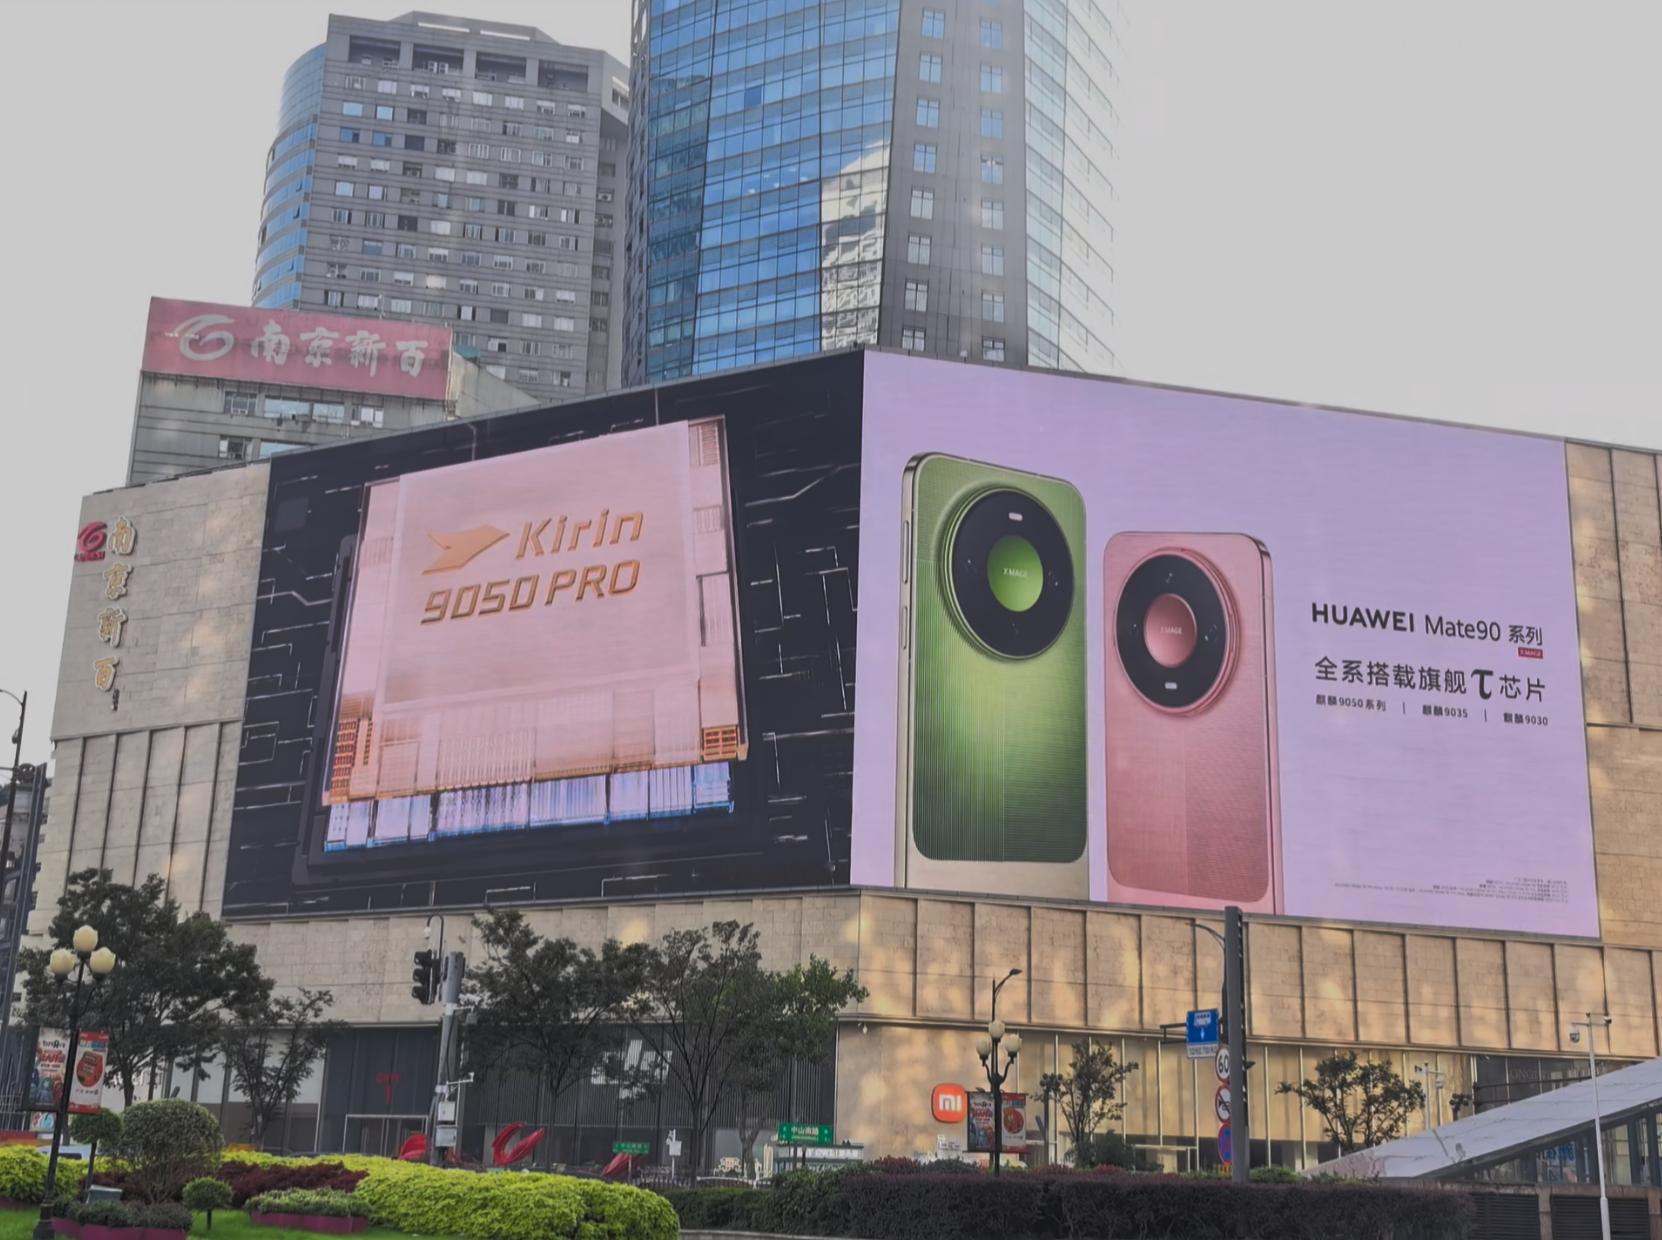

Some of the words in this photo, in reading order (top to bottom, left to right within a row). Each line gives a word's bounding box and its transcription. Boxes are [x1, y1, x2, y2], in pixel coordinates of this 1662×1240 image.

[251, 319, 428, 377] 南京新百
[515, 508, 644, 560] Kirin
[420, 574, 540, 625] 9050
[544, 559, 641, 607] PRO
[1311, 602, 1415, 632] HUAWEI
[1424, 614, 1501, 642] Mate90
[1508, 624, 1543, 646] 系列
[1218, 1054, 1229, 1074] 60
